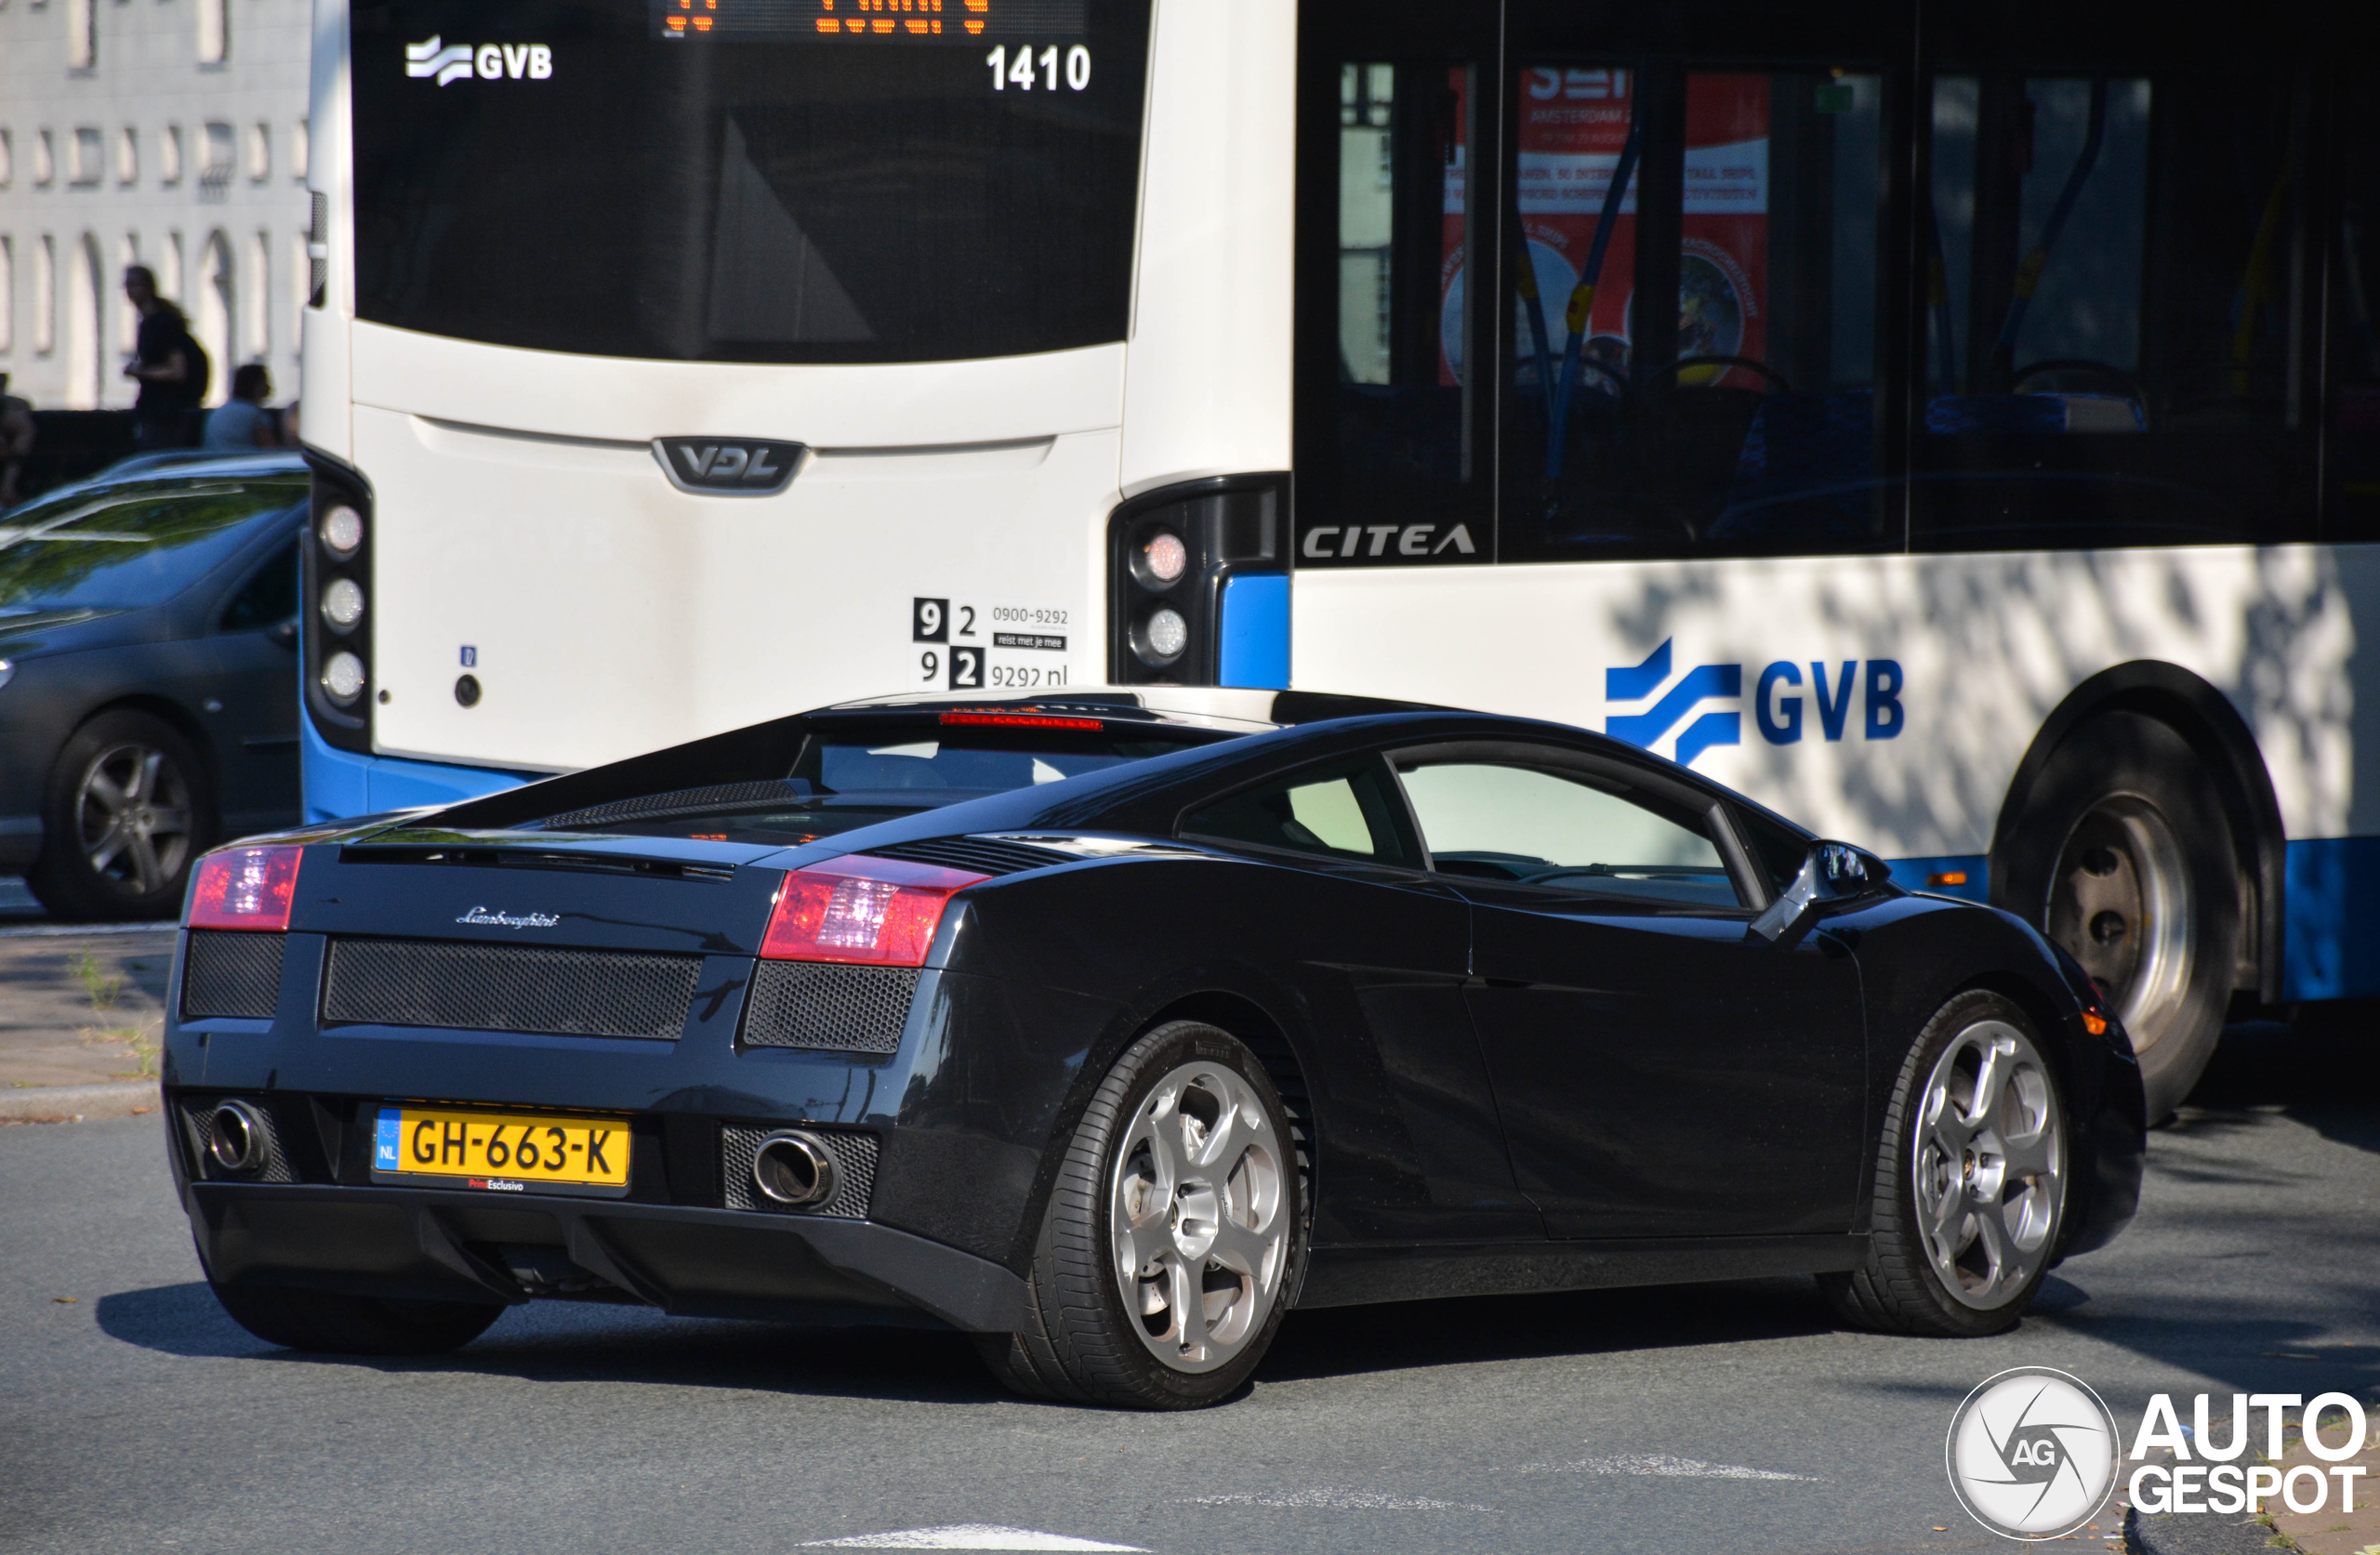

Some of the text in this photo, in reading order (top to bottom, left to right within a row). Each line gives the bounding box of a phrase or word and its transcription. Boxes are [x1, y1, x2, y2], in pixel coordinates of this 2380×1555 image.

[475, 43, 553, 80] GVB
[986, 44, 1091, 91] 1410
[1529, 109, 1621, 124] AMSTERDAM
[679, 445, 779, 479] VDL
[1303, 524, 1475, 558] CITEA
[993, 607, 1068, 625] 0900-9292
[998, 634, 1062, 648] reist met je mee
[1756, 659, 1904, 746] GVB
[456, 906, 560, 929] Lamborghini
[379, 1146, 396, 1160] NL
[413, 1119, 612, 1175] GH-663-K
